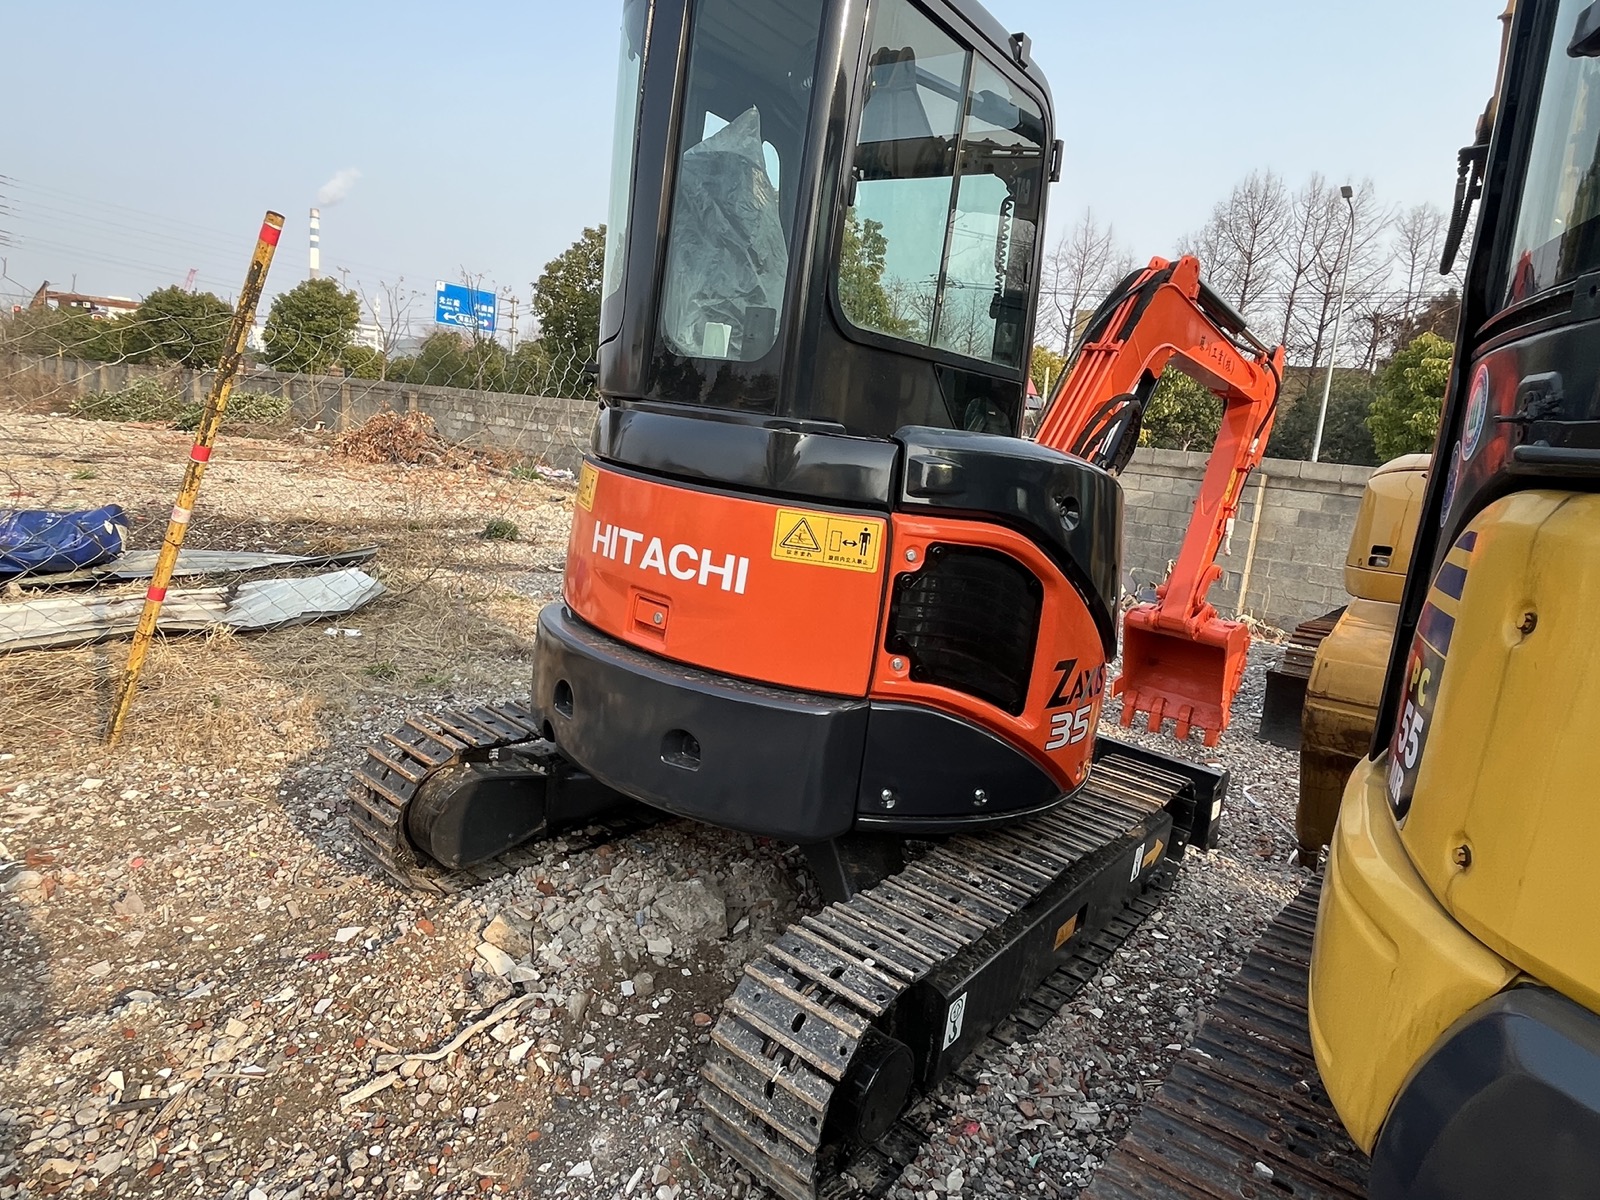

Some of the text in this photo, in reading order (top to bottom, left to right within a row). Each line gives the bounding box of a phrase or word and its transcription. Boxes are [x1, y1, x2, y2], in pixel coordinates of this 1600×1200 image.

[592, 520, 749, 595] HITACHI
[1409, 655, 1431, 707] PC
[1044, 703, 1093, 751] 35
[1398, 699, 1424, 769] 55
